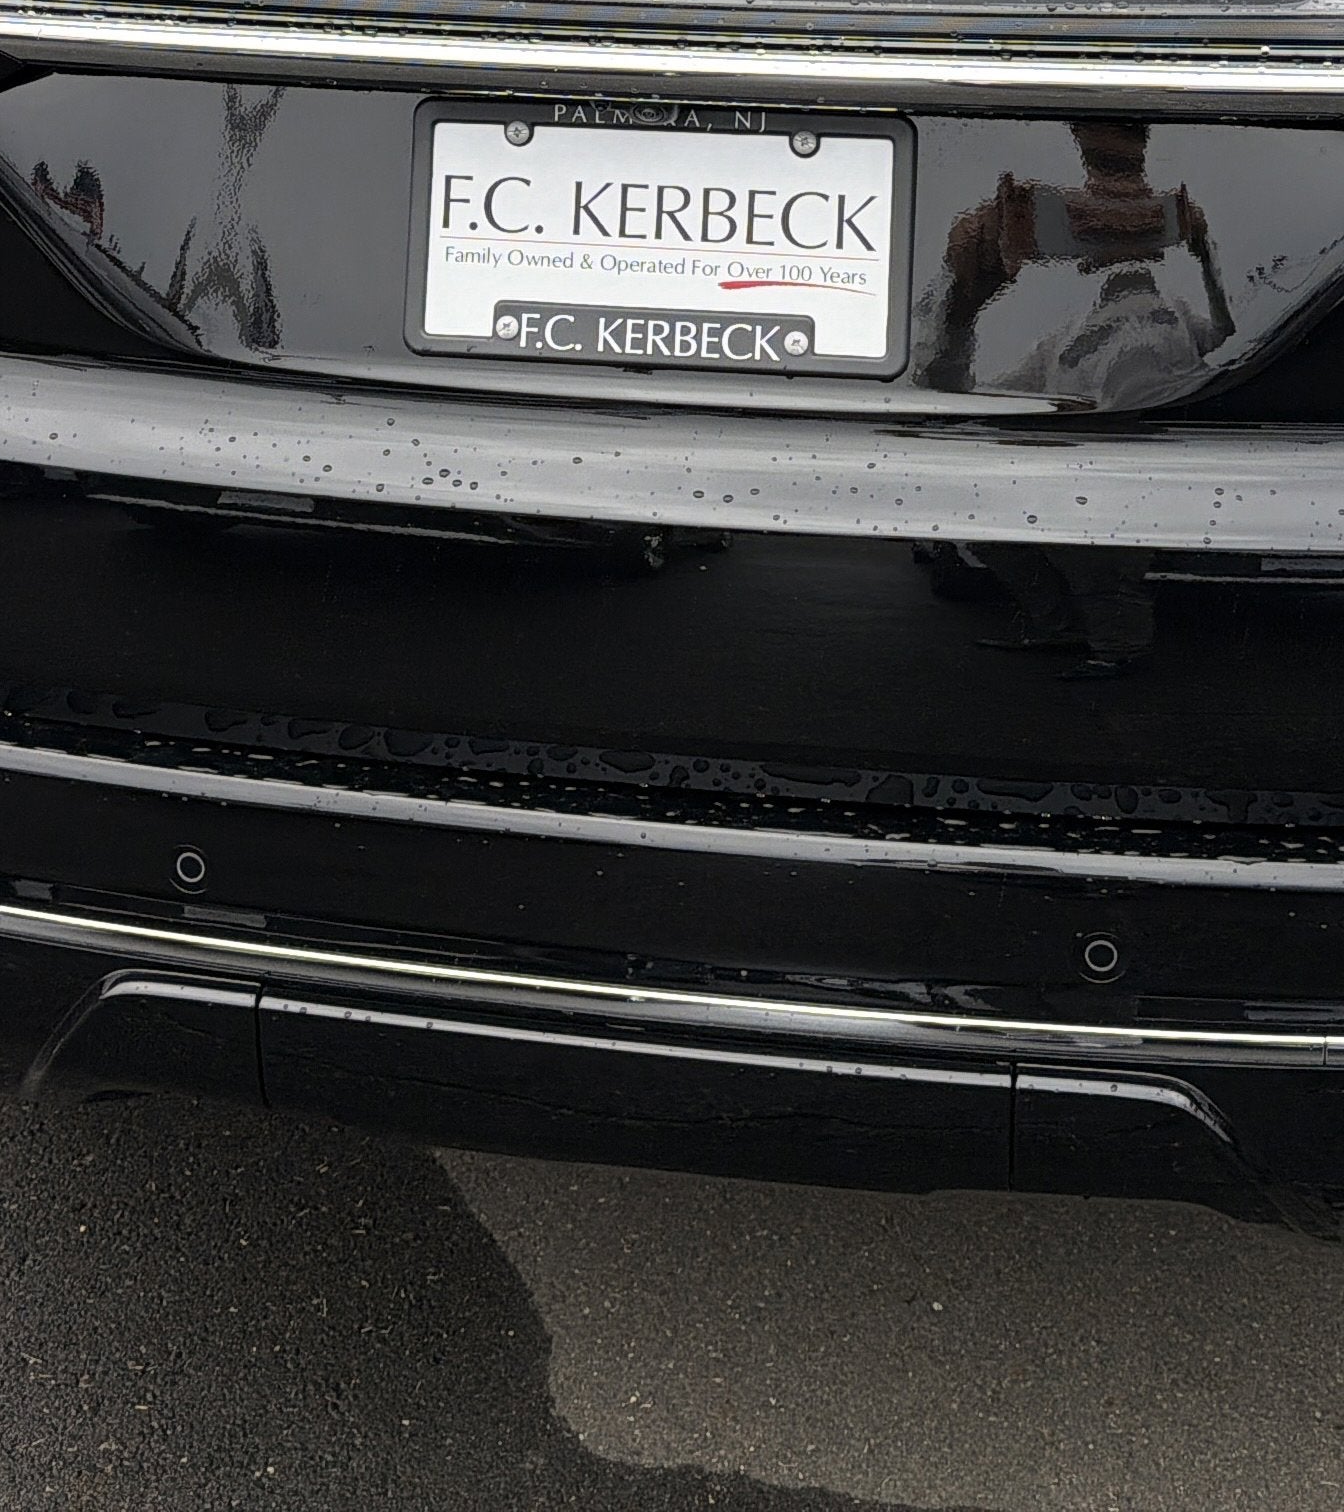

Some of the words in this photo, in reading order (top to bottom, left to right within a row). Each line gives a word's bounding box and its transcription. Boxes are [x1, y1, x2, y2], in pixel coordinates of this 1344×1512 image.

[554, 104, 713, 131] PALMA,
[734, 111, 766, 132] NJ
[442, 174, 544, 234] F.C.
[572, 181, 879, 252] KERBECK
[445, 246, 503, 267] Family
[507, 249, 574, 269] Owned
[580, 254, 593, 270] &
[600, 253, 685, 275] Operated
[692, 259, 720, 277] For
[727, 261, 773, 279] Over
[779, 264, 812, 282] 100
[820, 266, 867, 285] Years
[519, 313, 582, 351] F.C.
[597, 317, 781, 362] KERBECK
